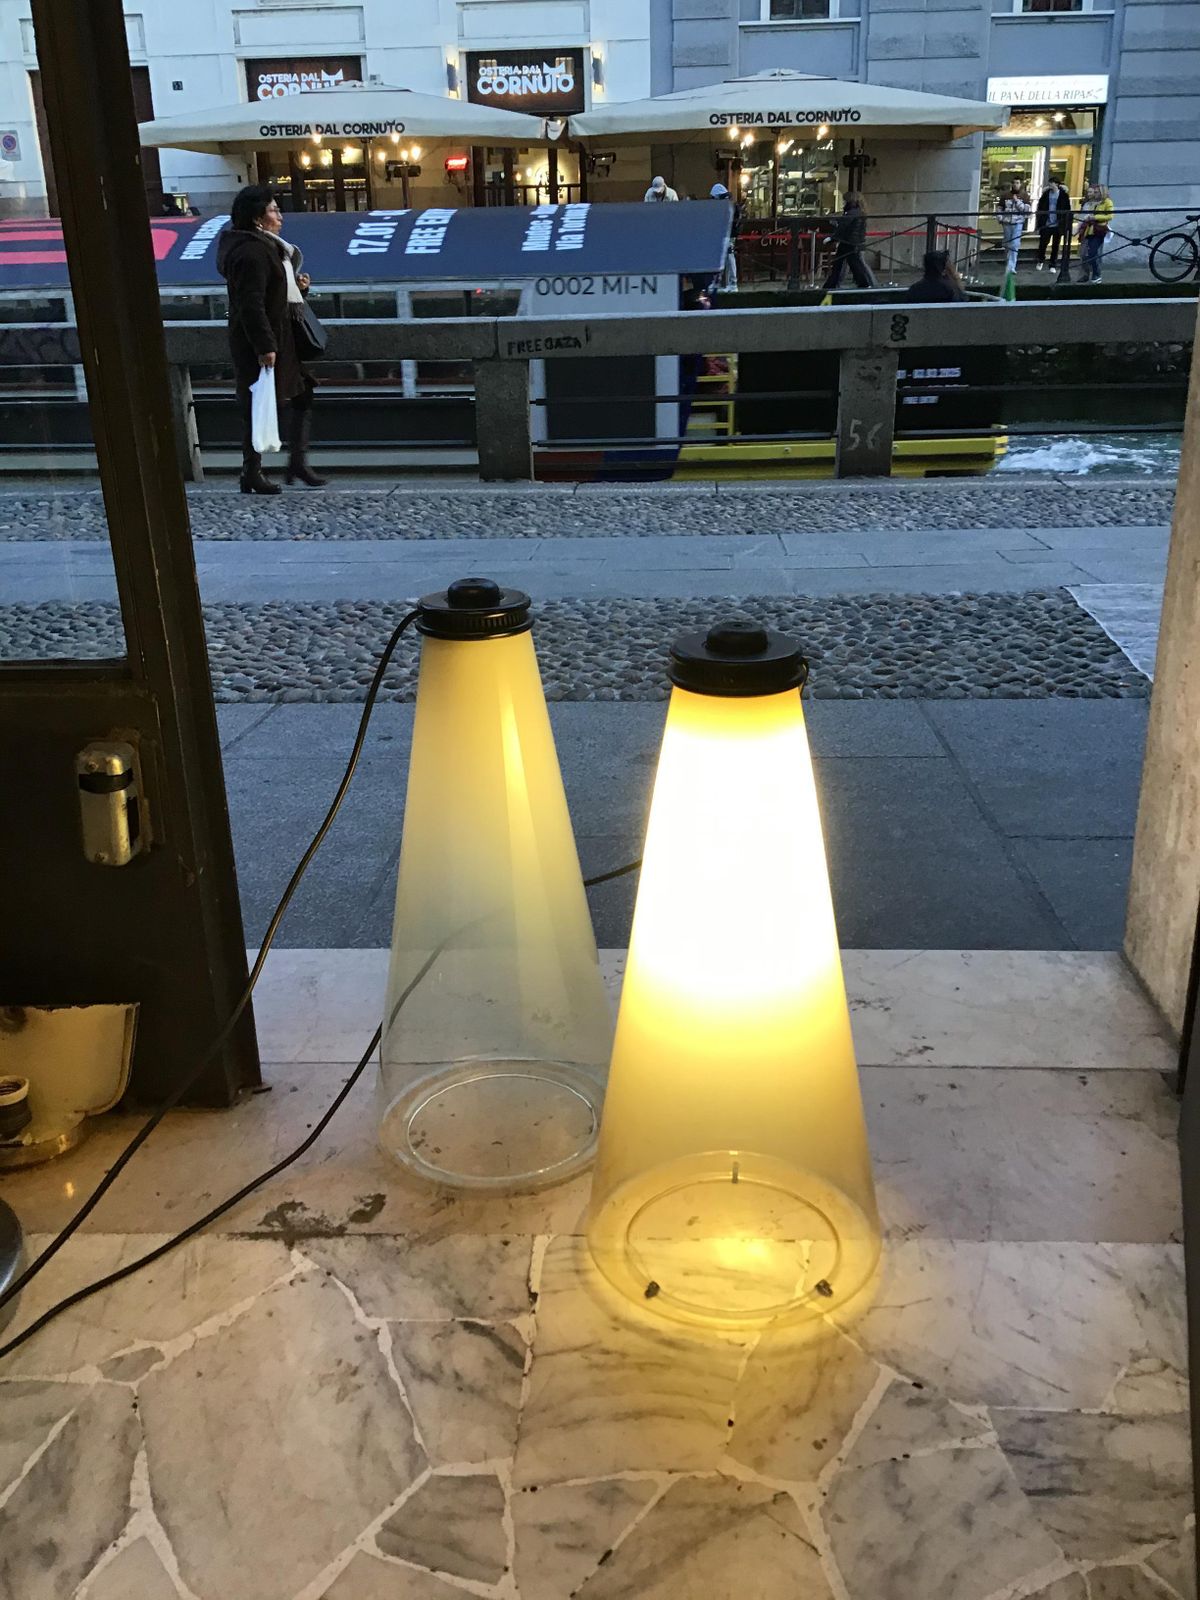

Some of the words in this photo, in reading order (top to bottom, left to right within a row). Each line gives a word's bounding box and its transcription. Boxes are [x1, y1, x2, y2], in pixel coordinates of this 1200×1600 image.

[258, 72, 299, 83] OSTERIA
[301, 72, 320, 82] DAL
[477, 62, 575, 95] CORNUTO
[478, 65, 520, 76] OSTERIA
[521, 64, 542, 75] DAL
[1000, 91, 1026, 101] PANE
[1028, 90, 1061, 100] DELLA
[1063, 89, 1086, 99] RIPA
[709, 111, 764, 125] OSTERIA
[767, 111, 792, 124] DAL
[796, 108, 861, 123] CORNUTO
[259, 123, 312, 136] OSTERIA
[315, 123, 339, 135] DAL
[342, 120, 405, 134] CORNUTO
[404, 226, 447, 254] FREE
[521, 220, 554, 251] Mudec
[555, 233, 584, 250] Via
[535, 276, 595, 295] 0002
[602, 275, 657, 295] MI-N
[507, 338, 542, 356] FREE
[544, 336, 582, 350] GAZA
